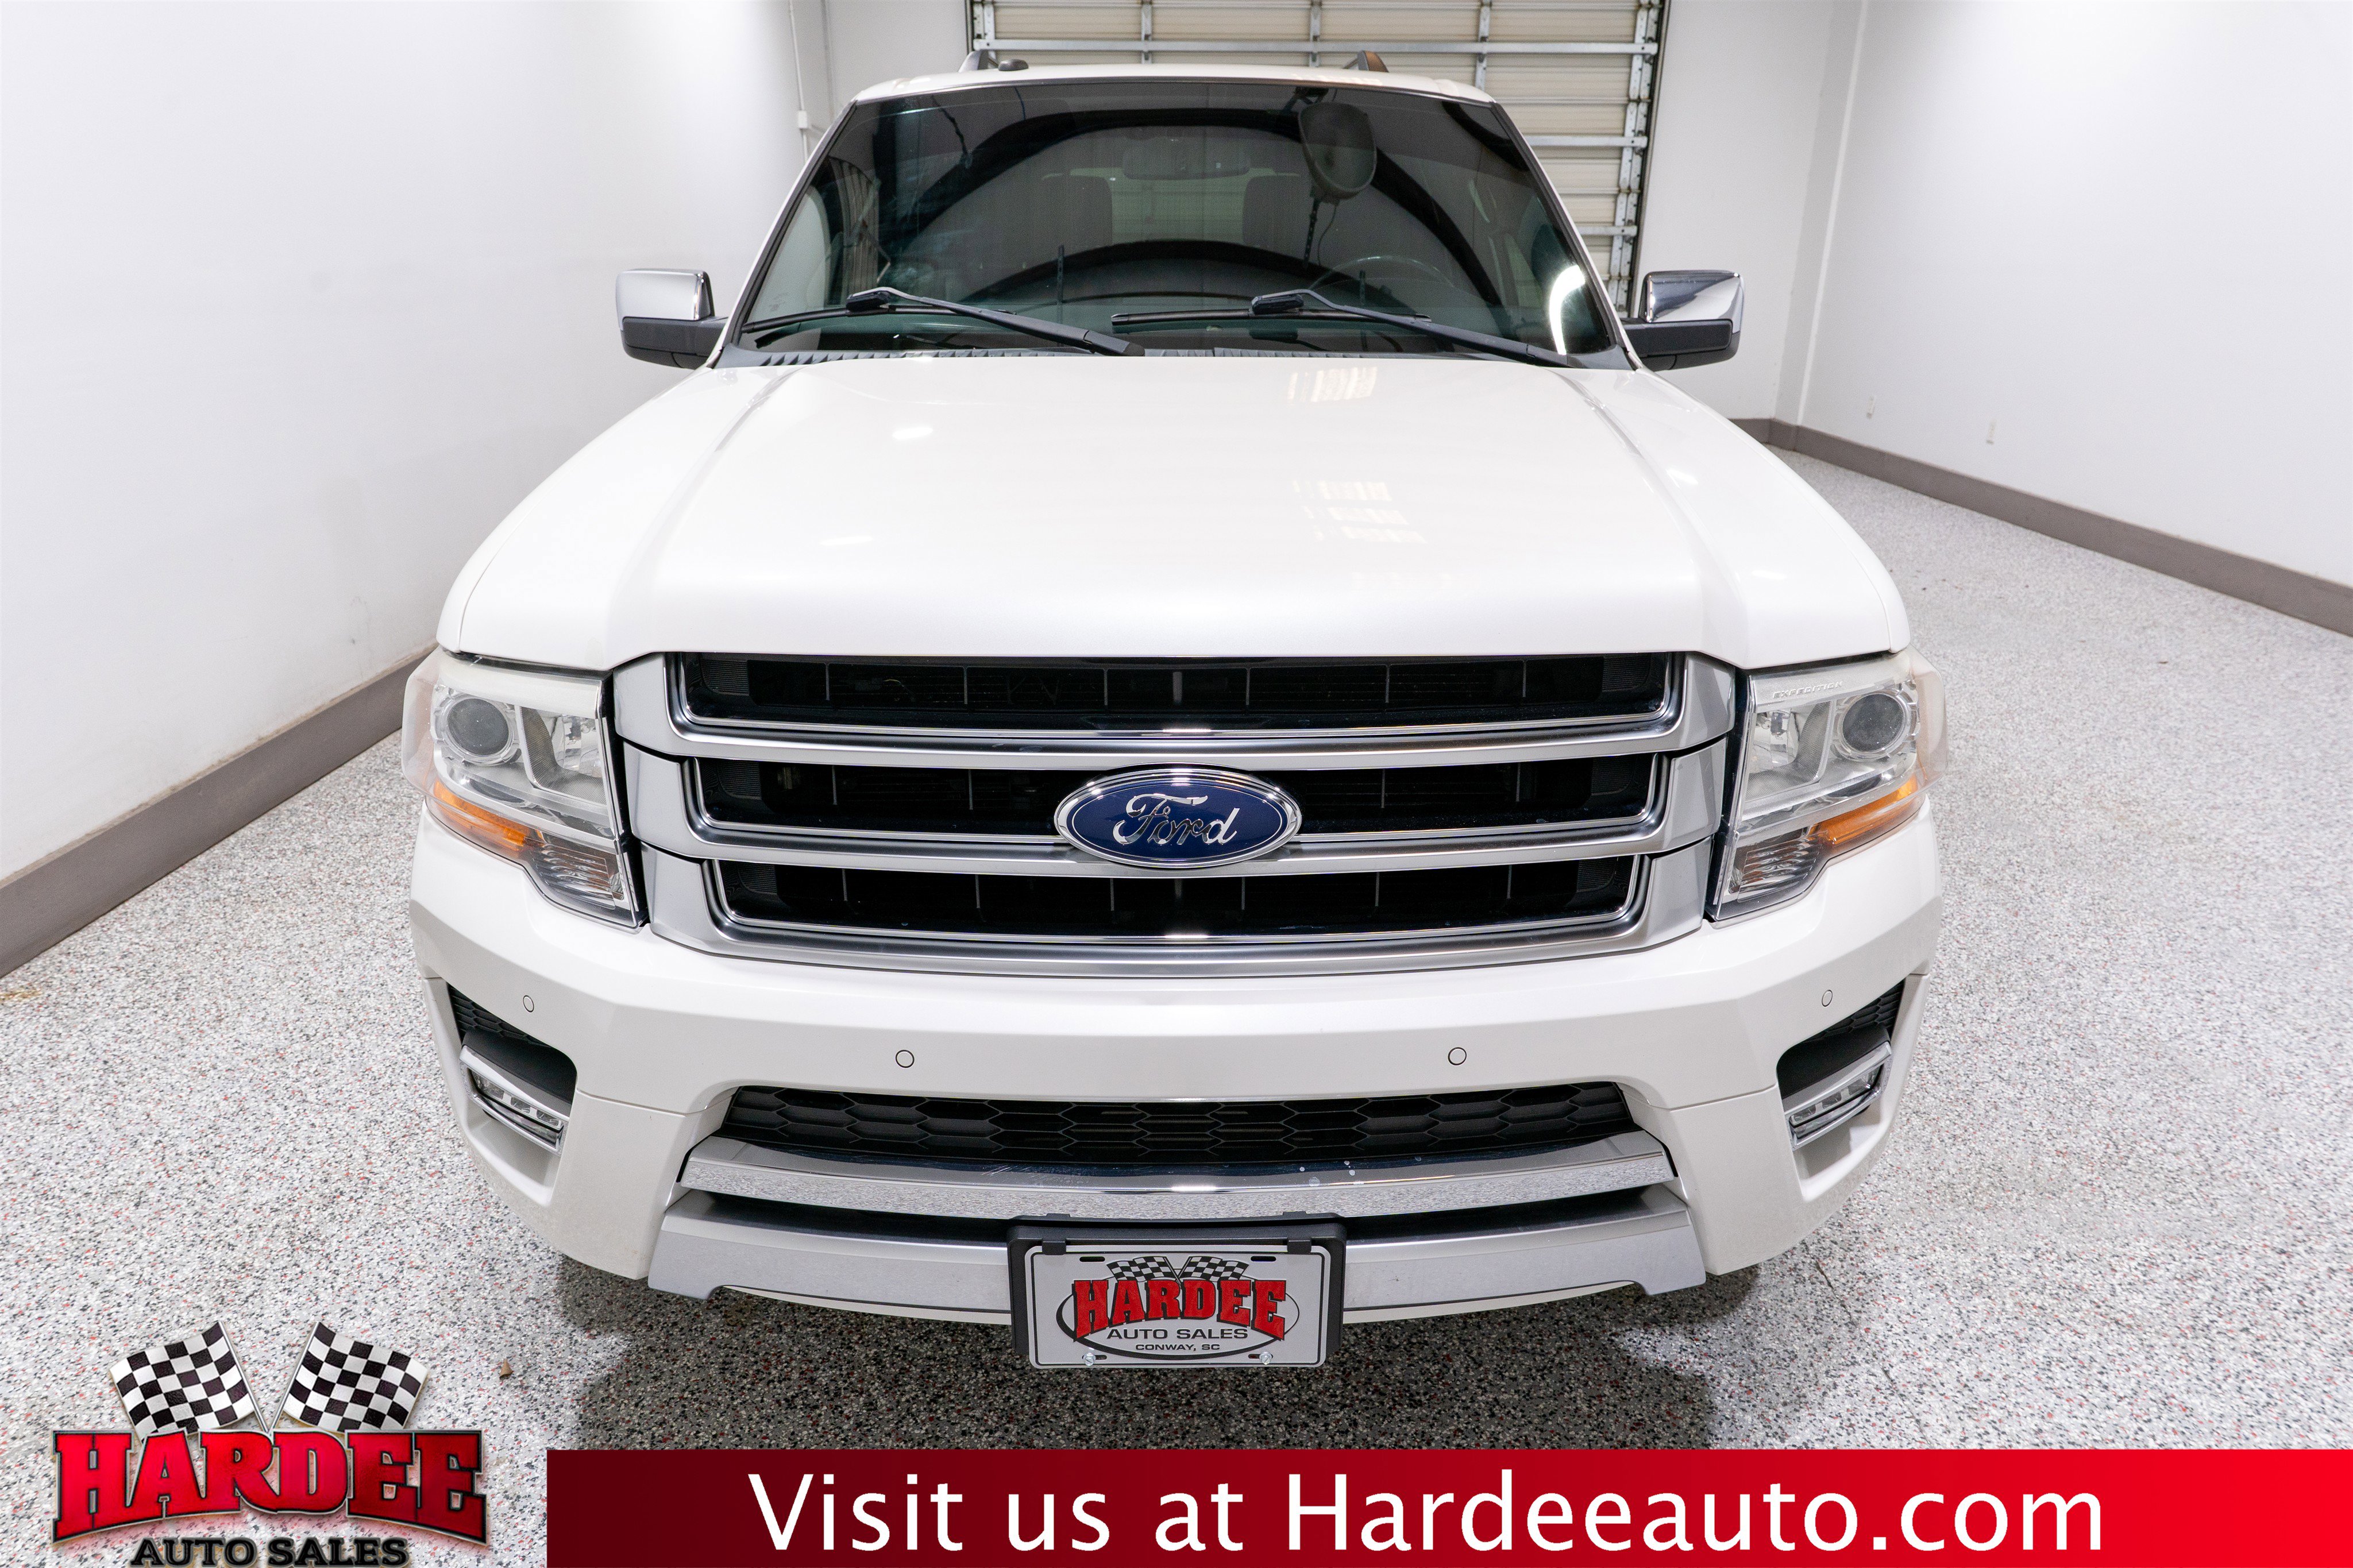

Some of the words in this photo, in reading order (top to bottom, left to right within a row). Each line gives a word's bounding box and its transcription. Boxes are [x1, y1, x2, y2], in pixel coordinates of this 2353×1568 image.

[1773, 681, 1843, 698] EXPEDITION
[1113, 793, 1240, 845] Ford
[1072, 1280, 1287, 1342] HARDEE
[1106, 1328, 1168, 1339] AUTO
[1176, 1328, 1248, 1339] SALES
